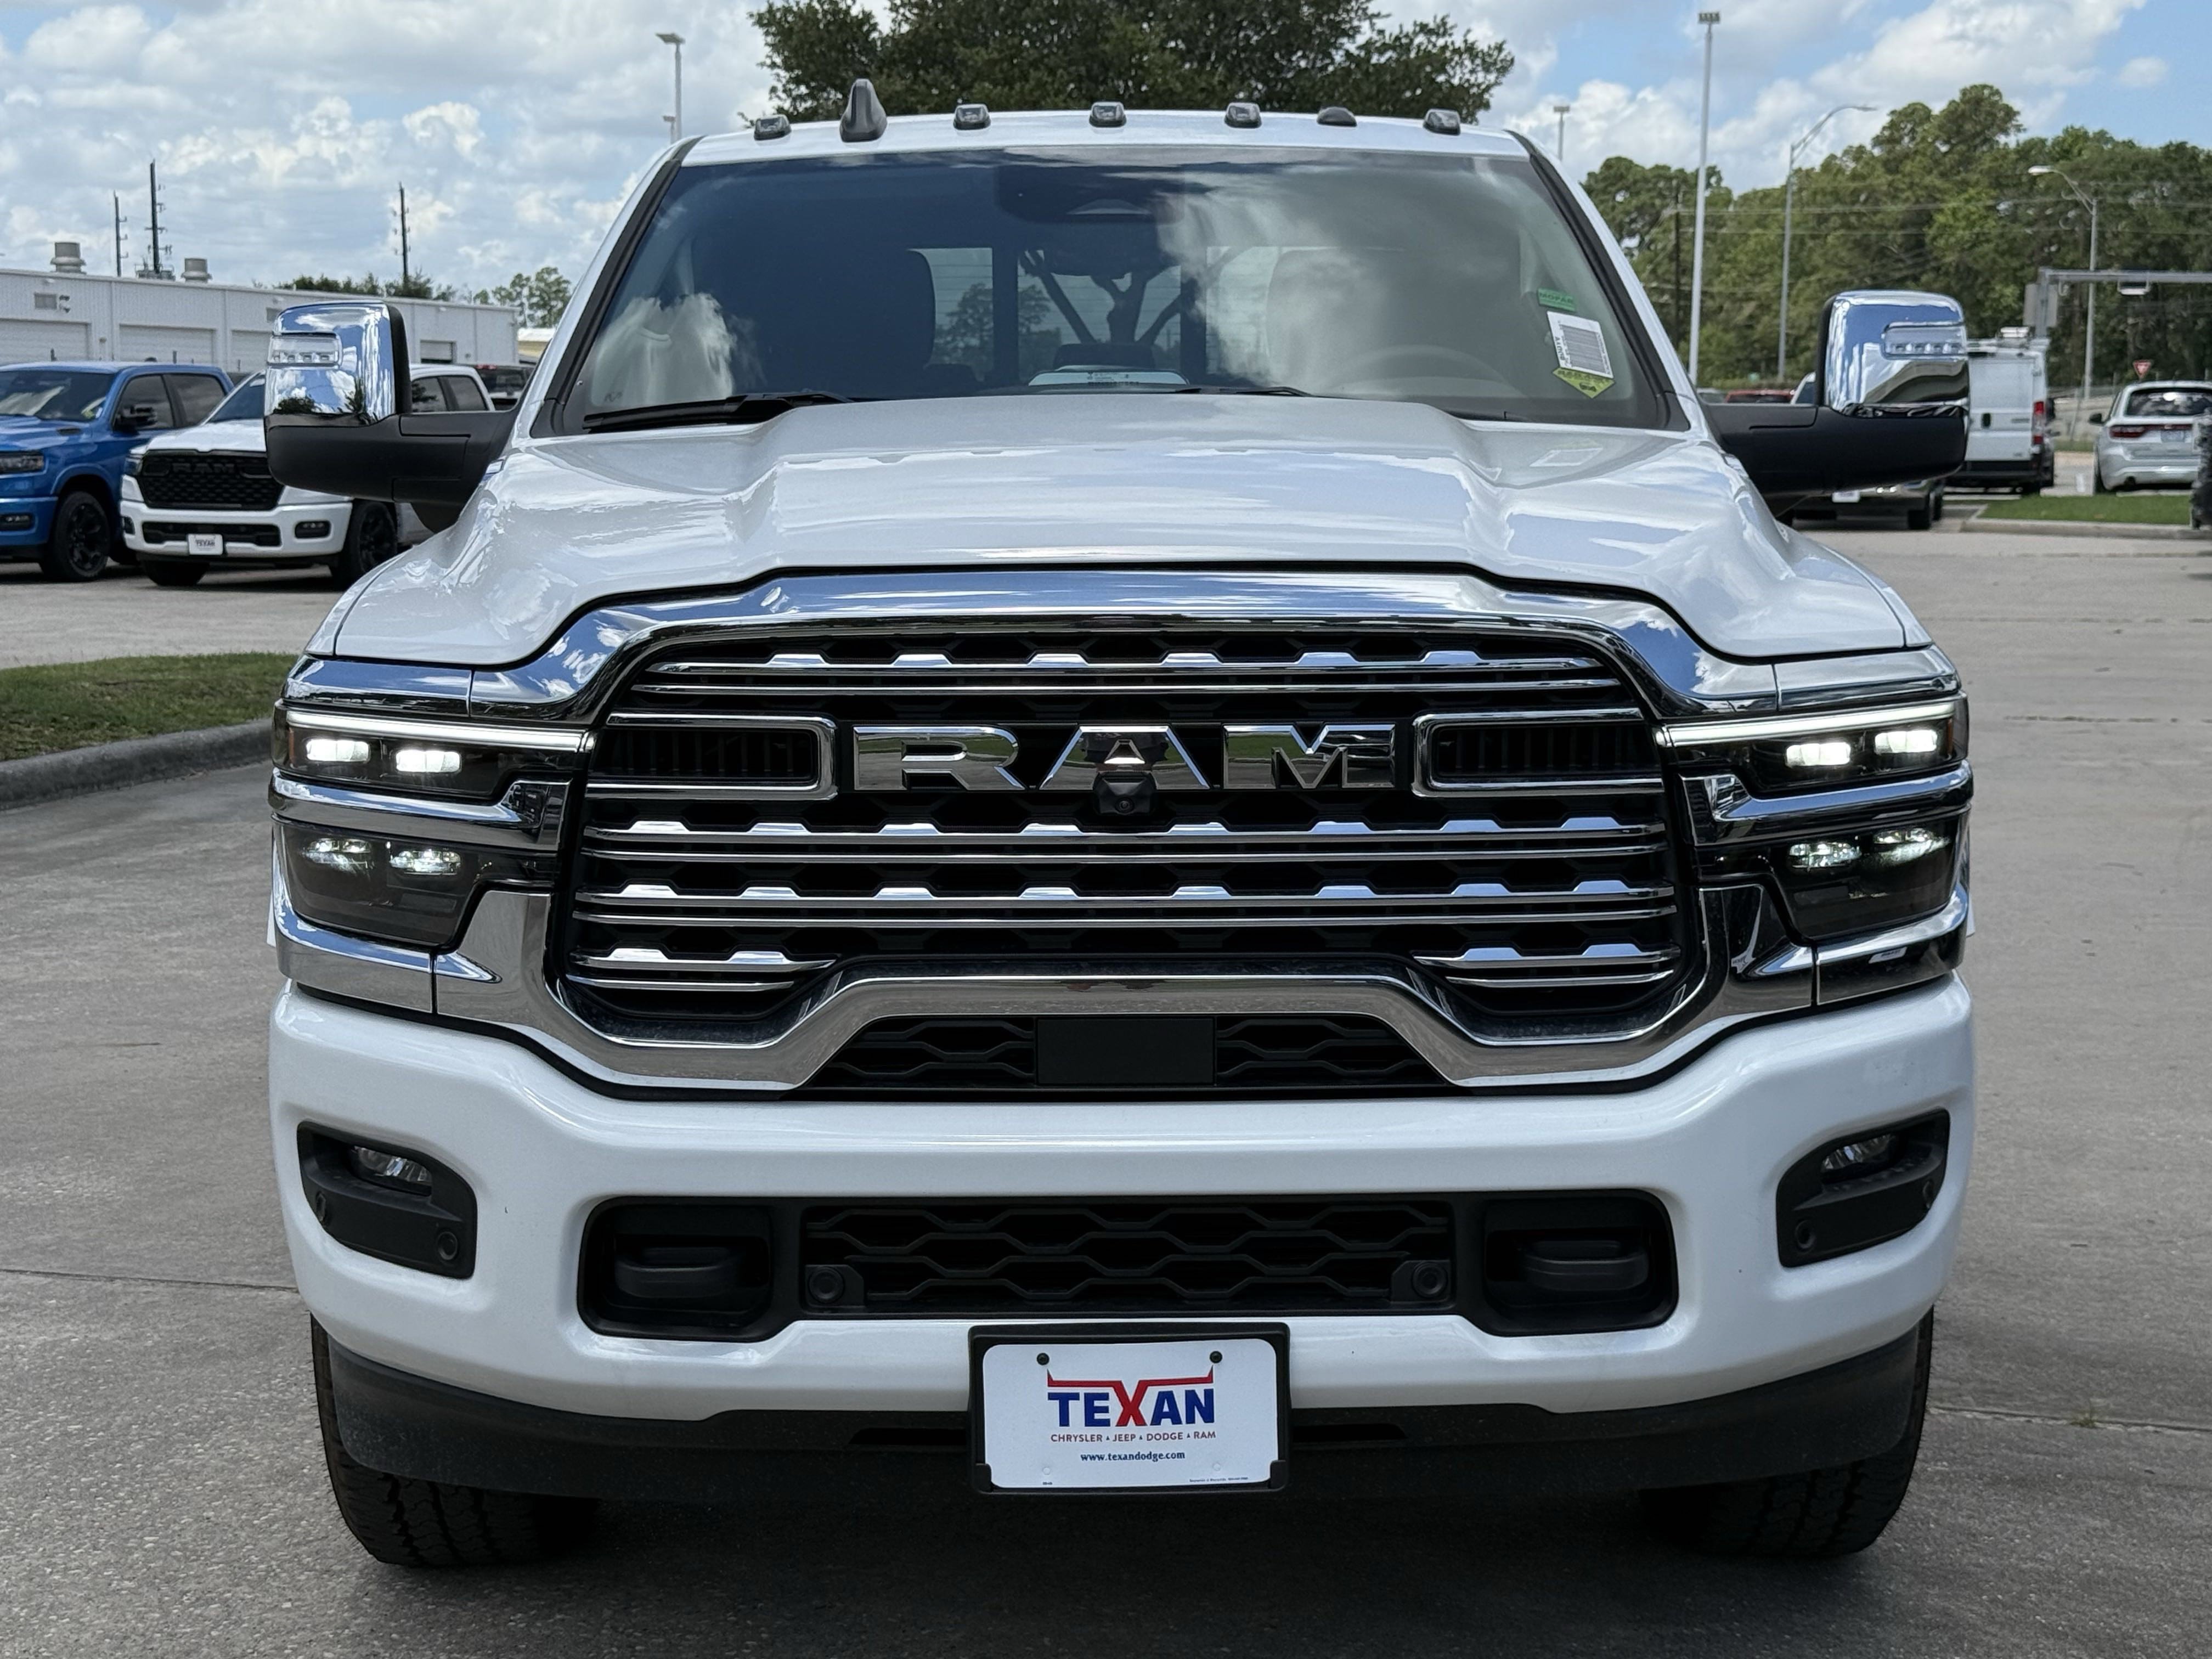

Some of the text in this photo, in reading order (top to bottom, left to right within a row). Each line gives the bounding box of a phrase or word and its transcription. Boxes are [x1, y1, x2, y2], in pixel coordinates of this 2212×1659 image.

[172, 463, 235, 473] RAM
[854, 724, 1396, 790] RAM
[1047, 1365, 1214, 1427] TEXAN
[1051, 1431, 1216, 1443] CHRYSLER JEEP DODGE RAM
[1080, 1451, 1186, 1462] www.texandodge.com
